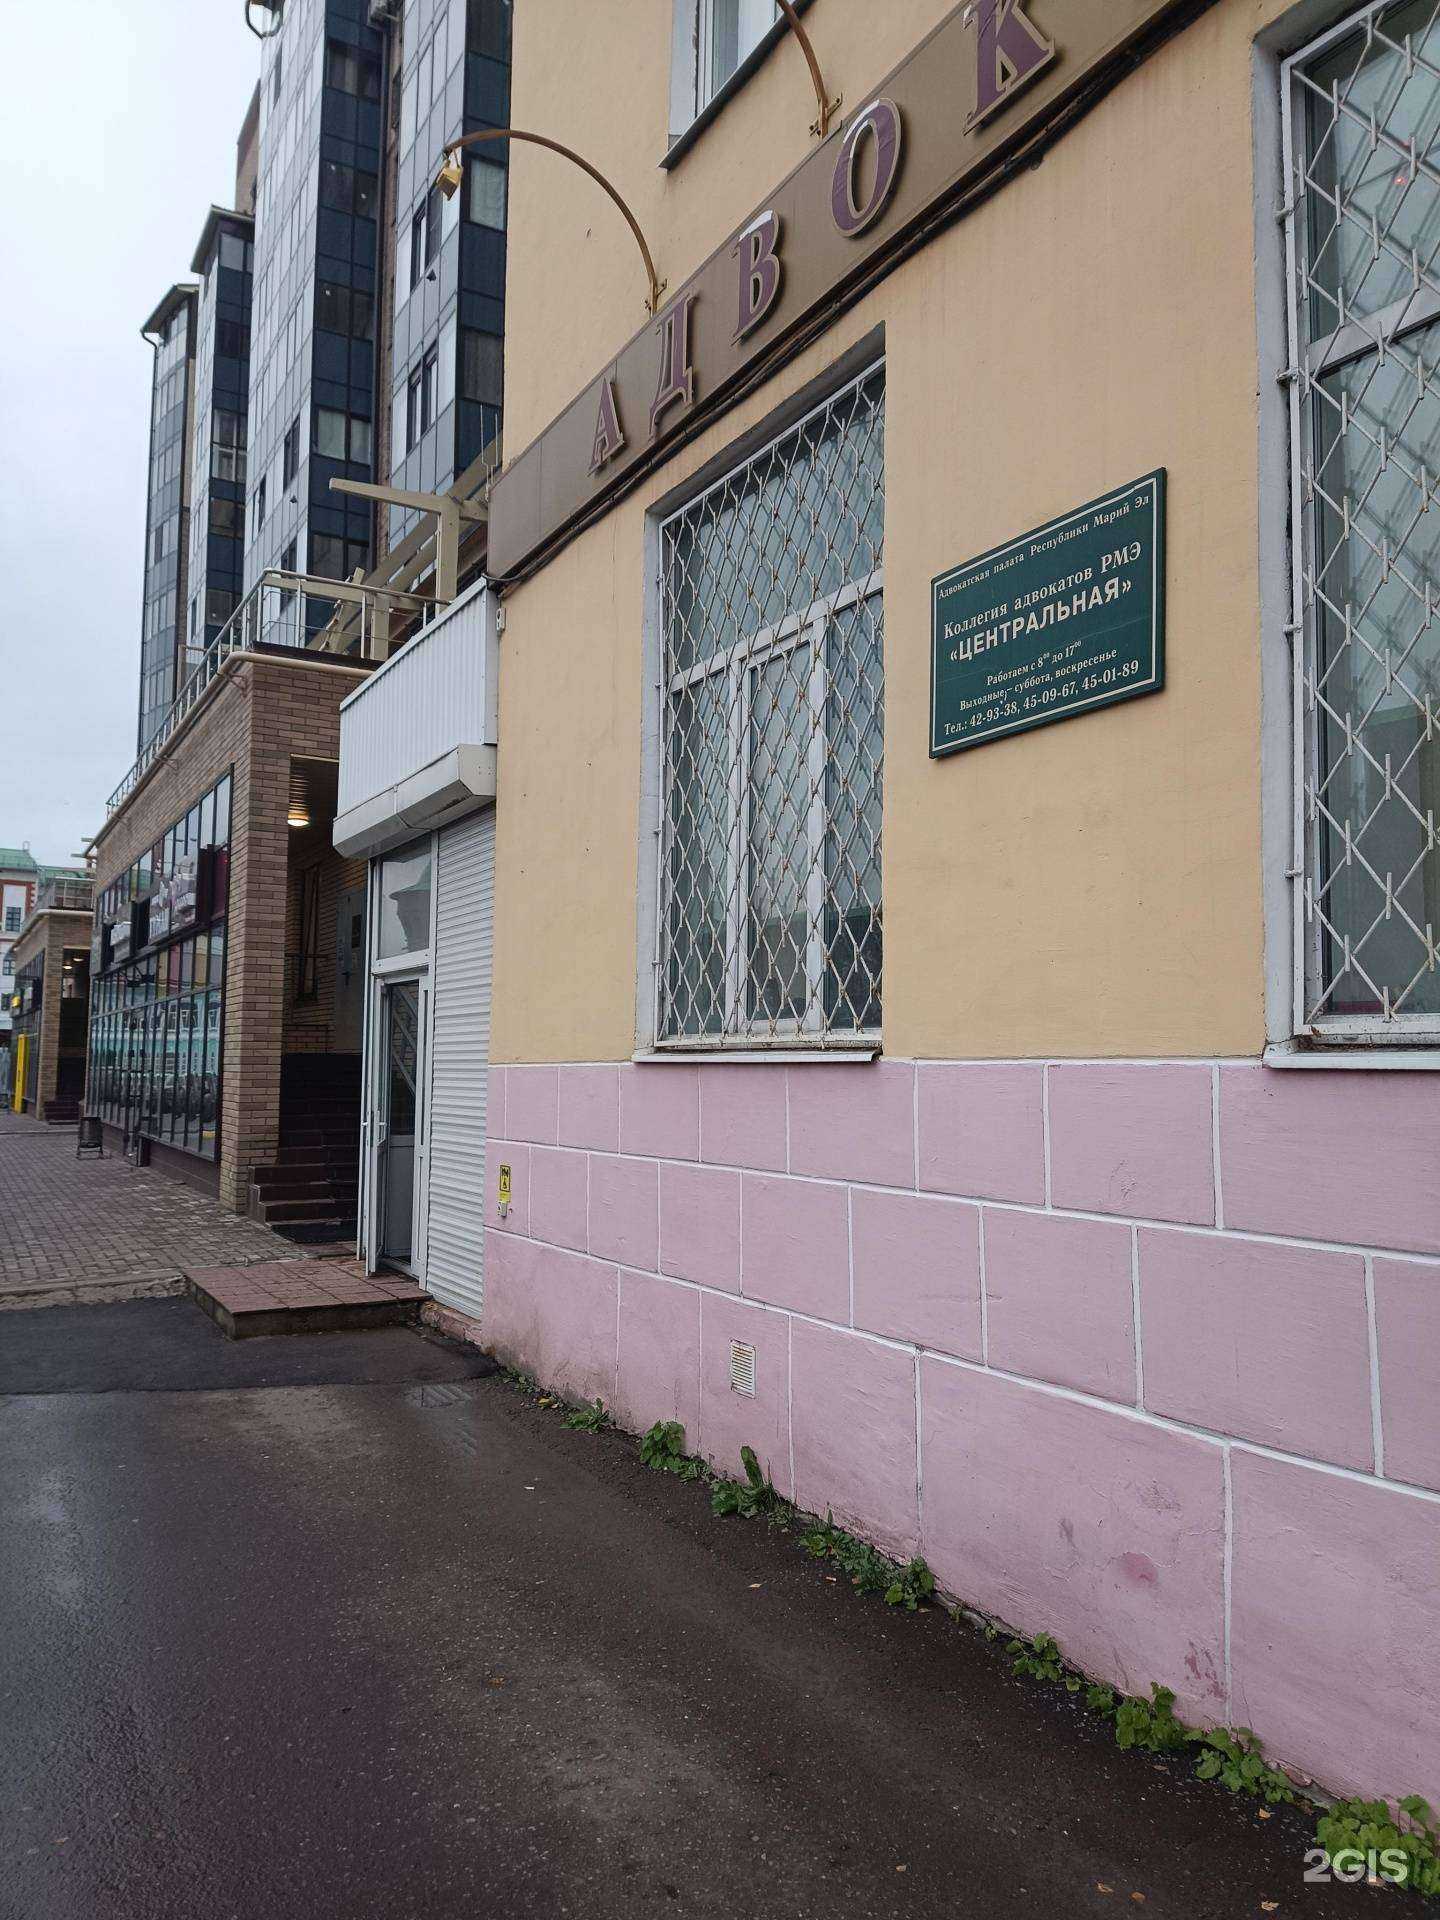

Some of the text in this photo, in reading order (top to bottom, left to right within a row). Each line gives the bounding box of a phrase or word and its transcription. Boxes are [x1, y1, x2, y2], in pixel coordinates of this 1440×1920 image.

[939, 495, 1149, 599] Адвокатская палата Республики Марий Эл
[944, 541, 1141, 639] Коллегия адвокатов РМЭ
[950, 576, 1132, 661] «ЦЕНТРАЛЬНАЯ»
[944, 659, 1139, 736] Тел.: 42-93-38, 45-09-67, 45-01-89
[987, 664, 1028, 686] Работаем
[1052, 652, 1063, 665] до
[1014, 673, 1053, 694] суббота,
[1055, 648, 1118, 678] воскресенье
